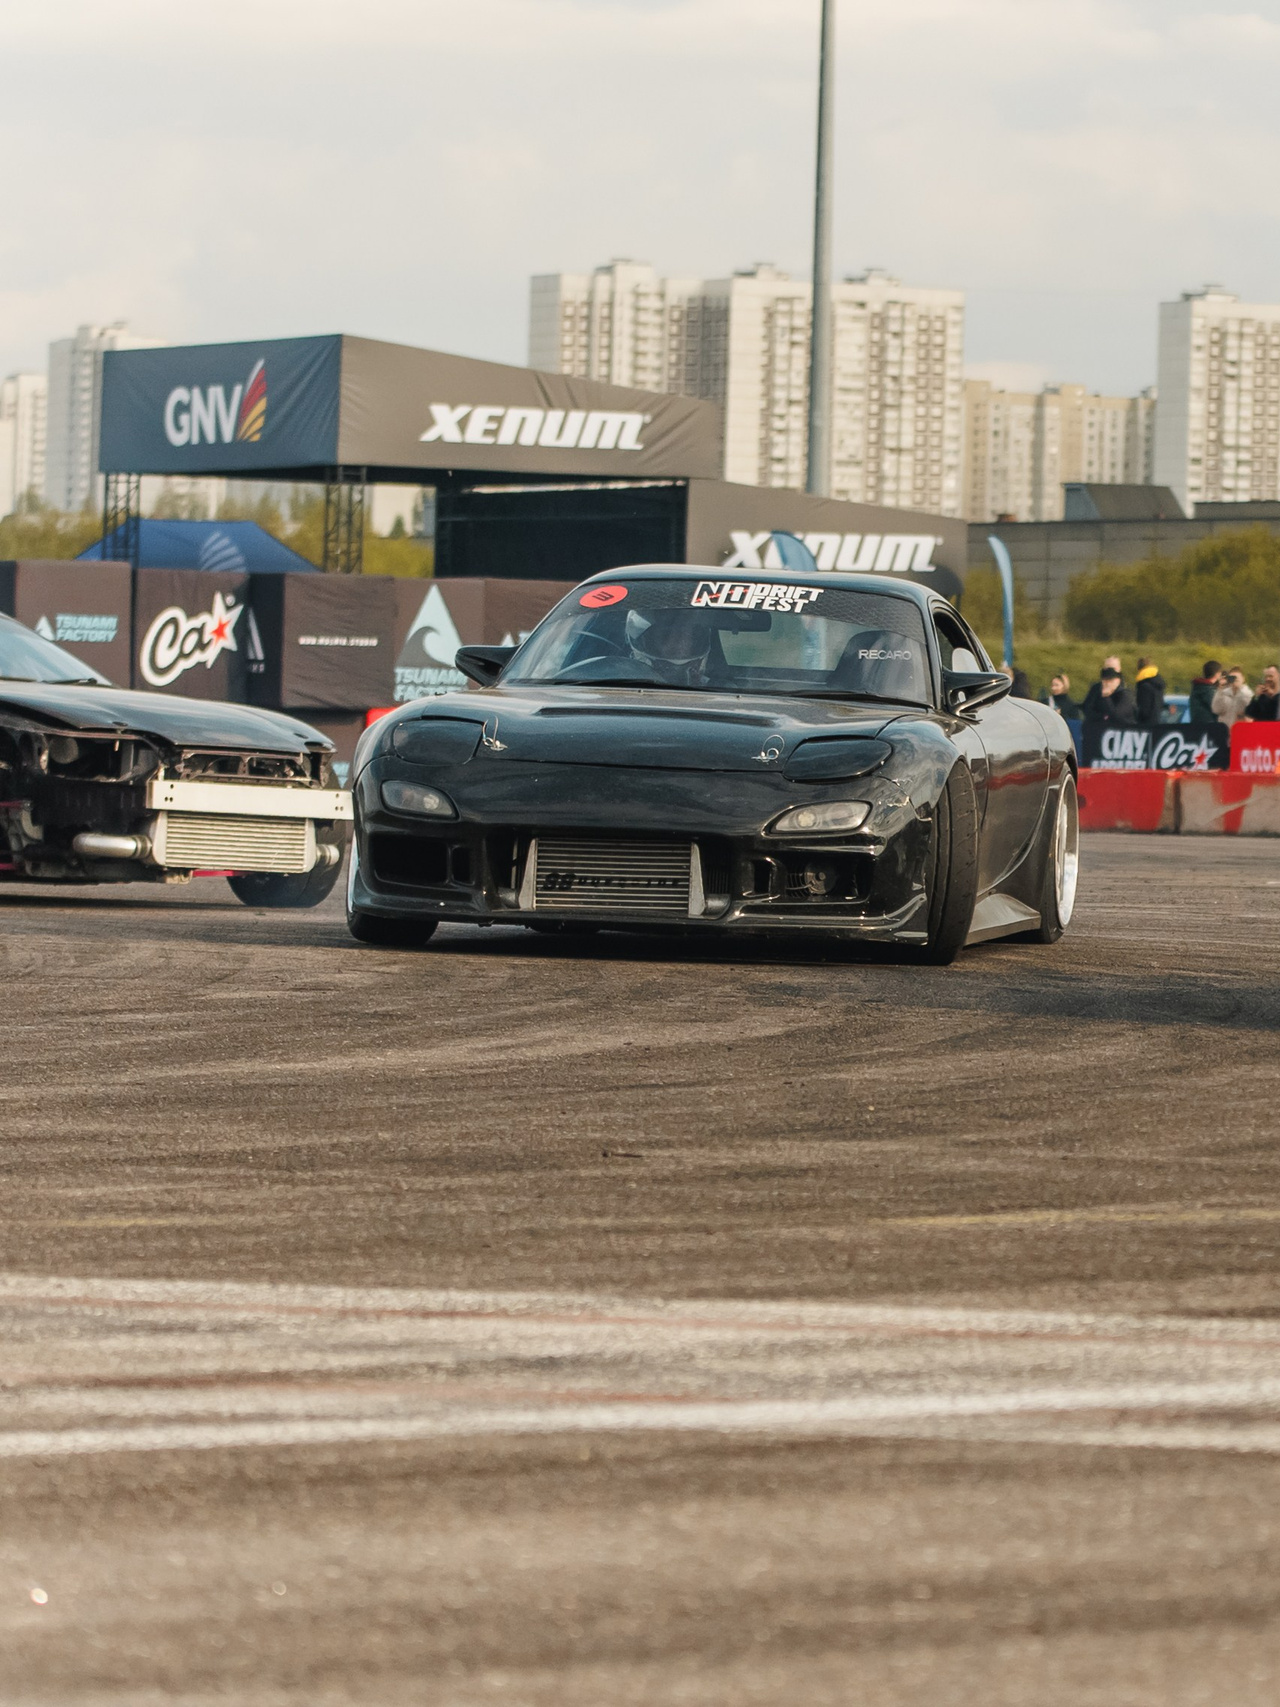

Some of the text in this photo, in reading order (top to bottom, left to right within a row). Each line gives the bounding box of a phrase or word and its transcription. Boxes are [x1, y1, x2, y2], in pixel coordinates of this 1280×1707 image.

[164, 384, 242, 447] GNV
[419, 402, 645, 450] XENUM
[753, 583, 824, 602] DRIFT
[748, 596, 809, 613] FEST
[56, 613, 118, 629] TSUNAMI
[56, 629, 117, 642] FACTORY
[858, 649, 912, 661] RECARO
